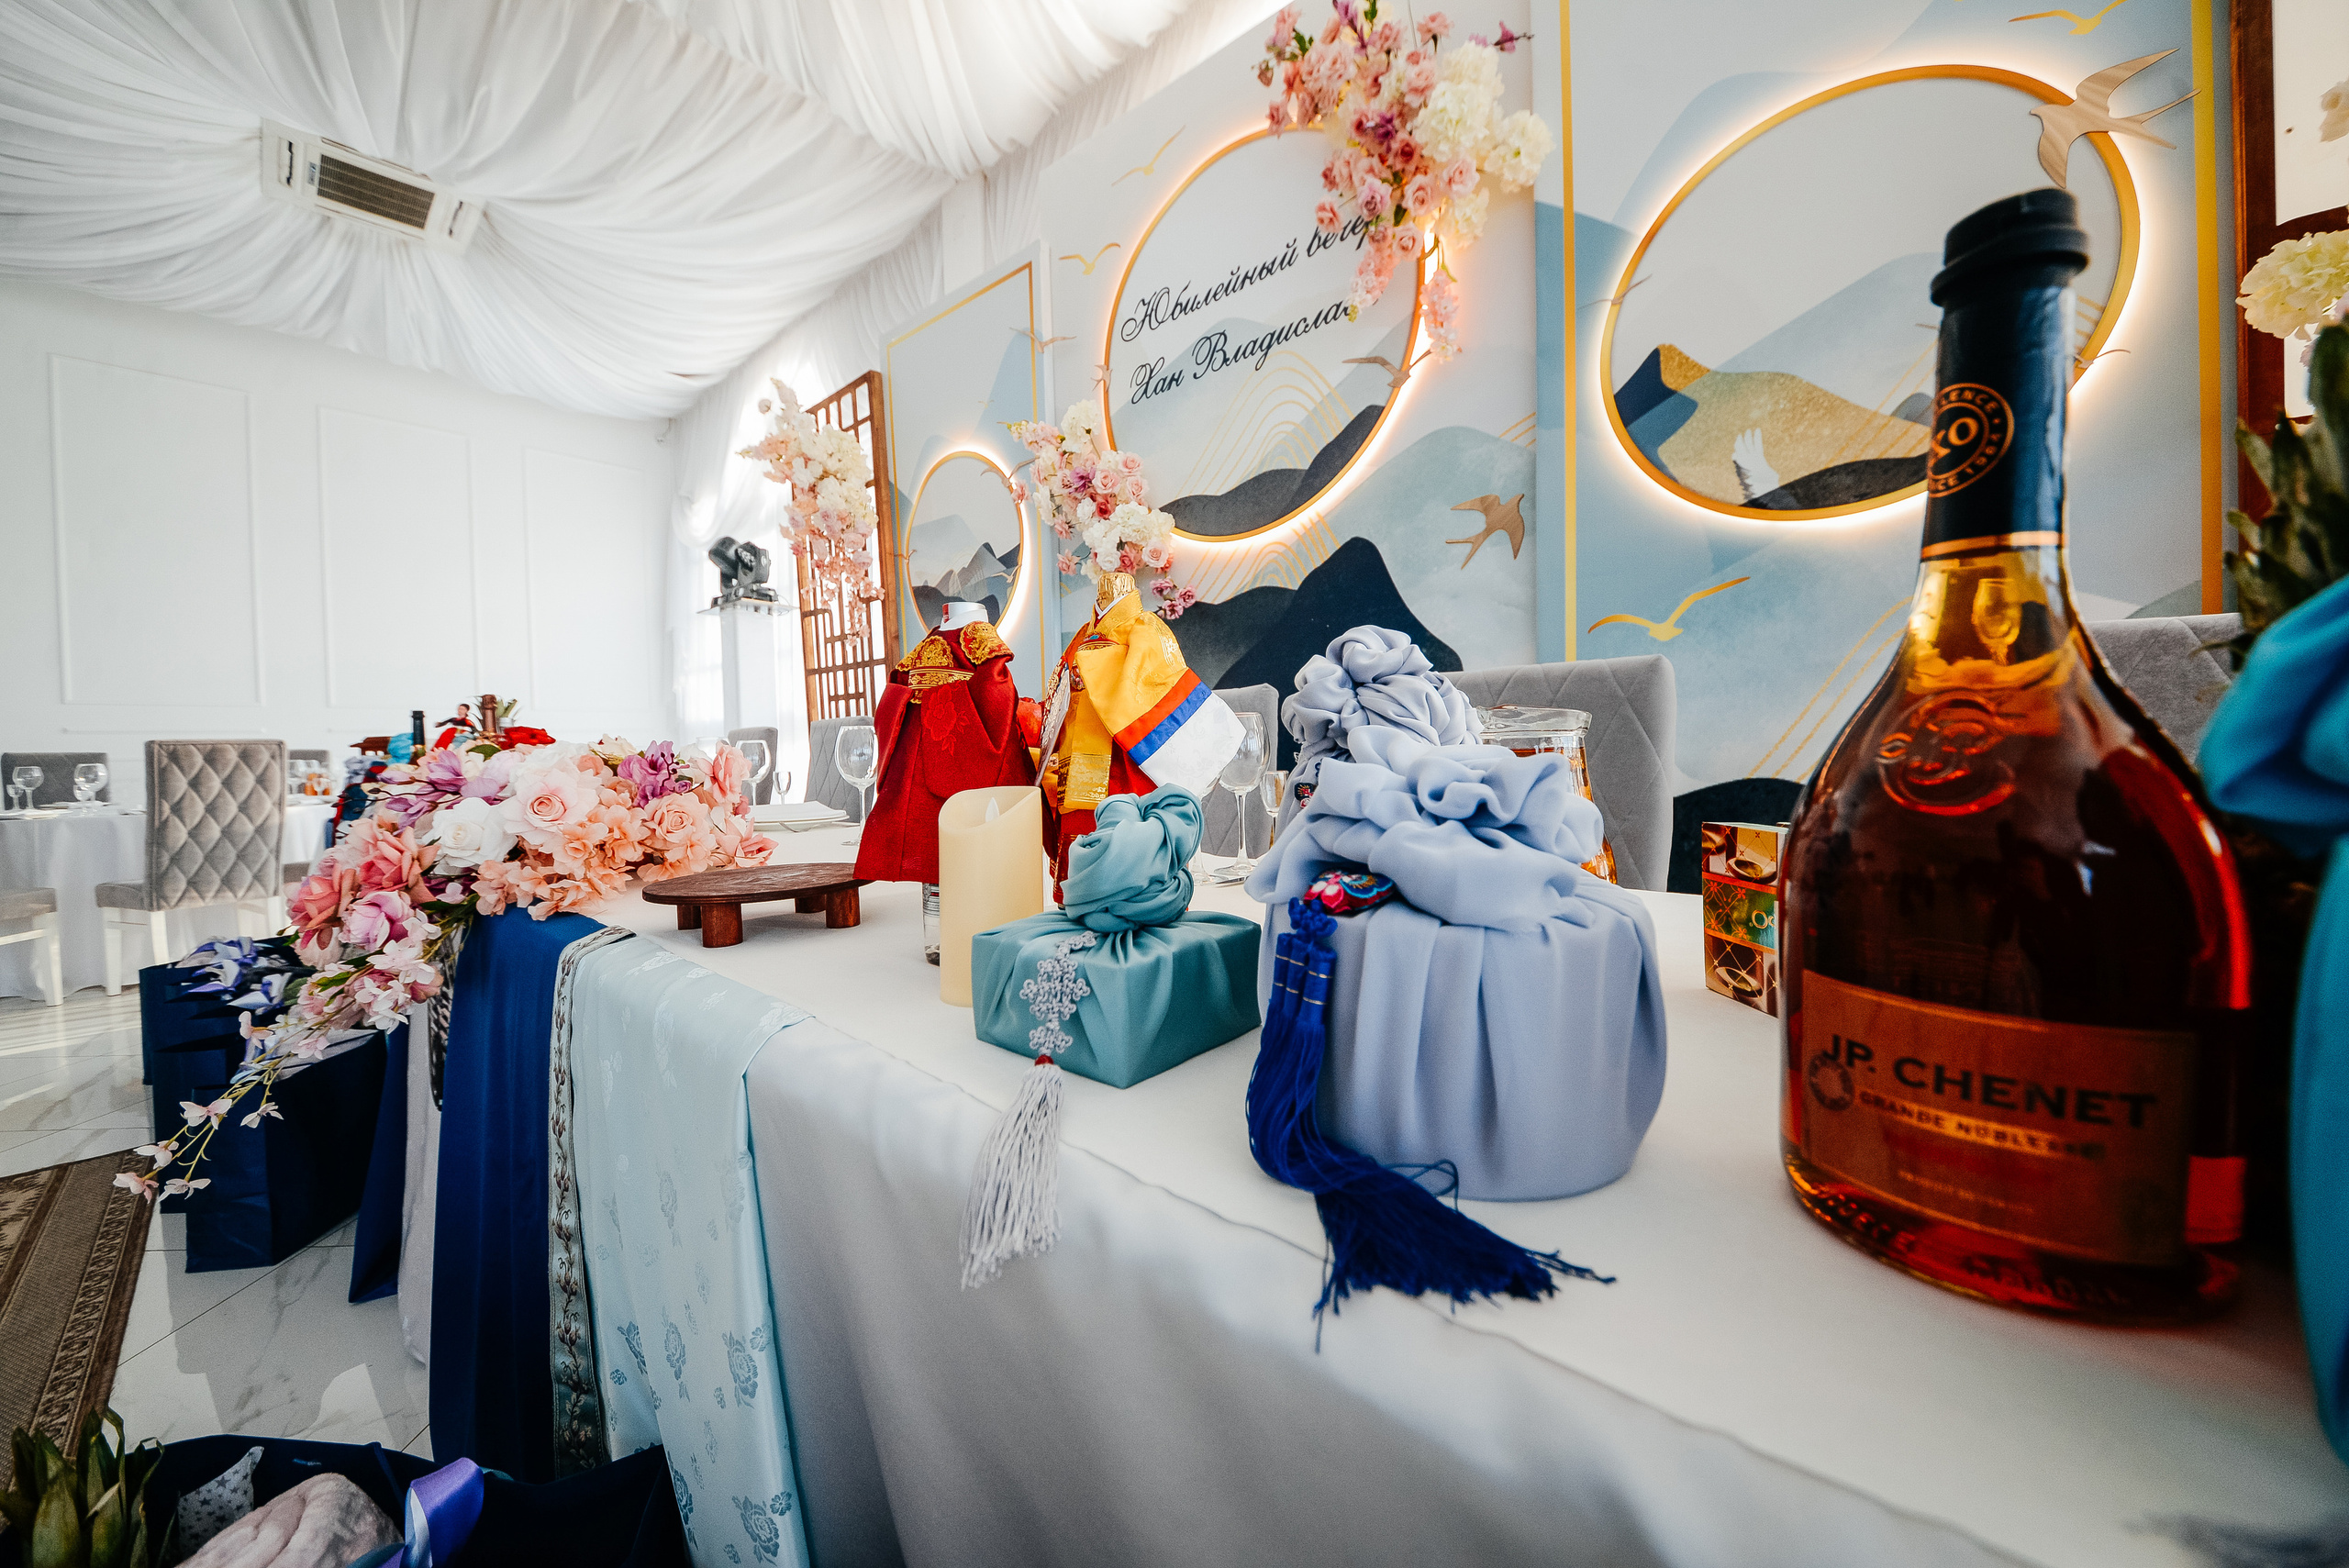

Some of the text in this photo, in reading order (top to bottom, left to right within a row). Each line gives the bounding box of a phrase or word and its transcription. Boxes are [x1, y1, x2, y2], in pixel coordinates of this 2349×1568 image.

[1120, 238, 1299, 342] Юбилейный
[1130, 357, 1185, 405] Хан
[1893, 1056, 2158, 1129] CHENET
